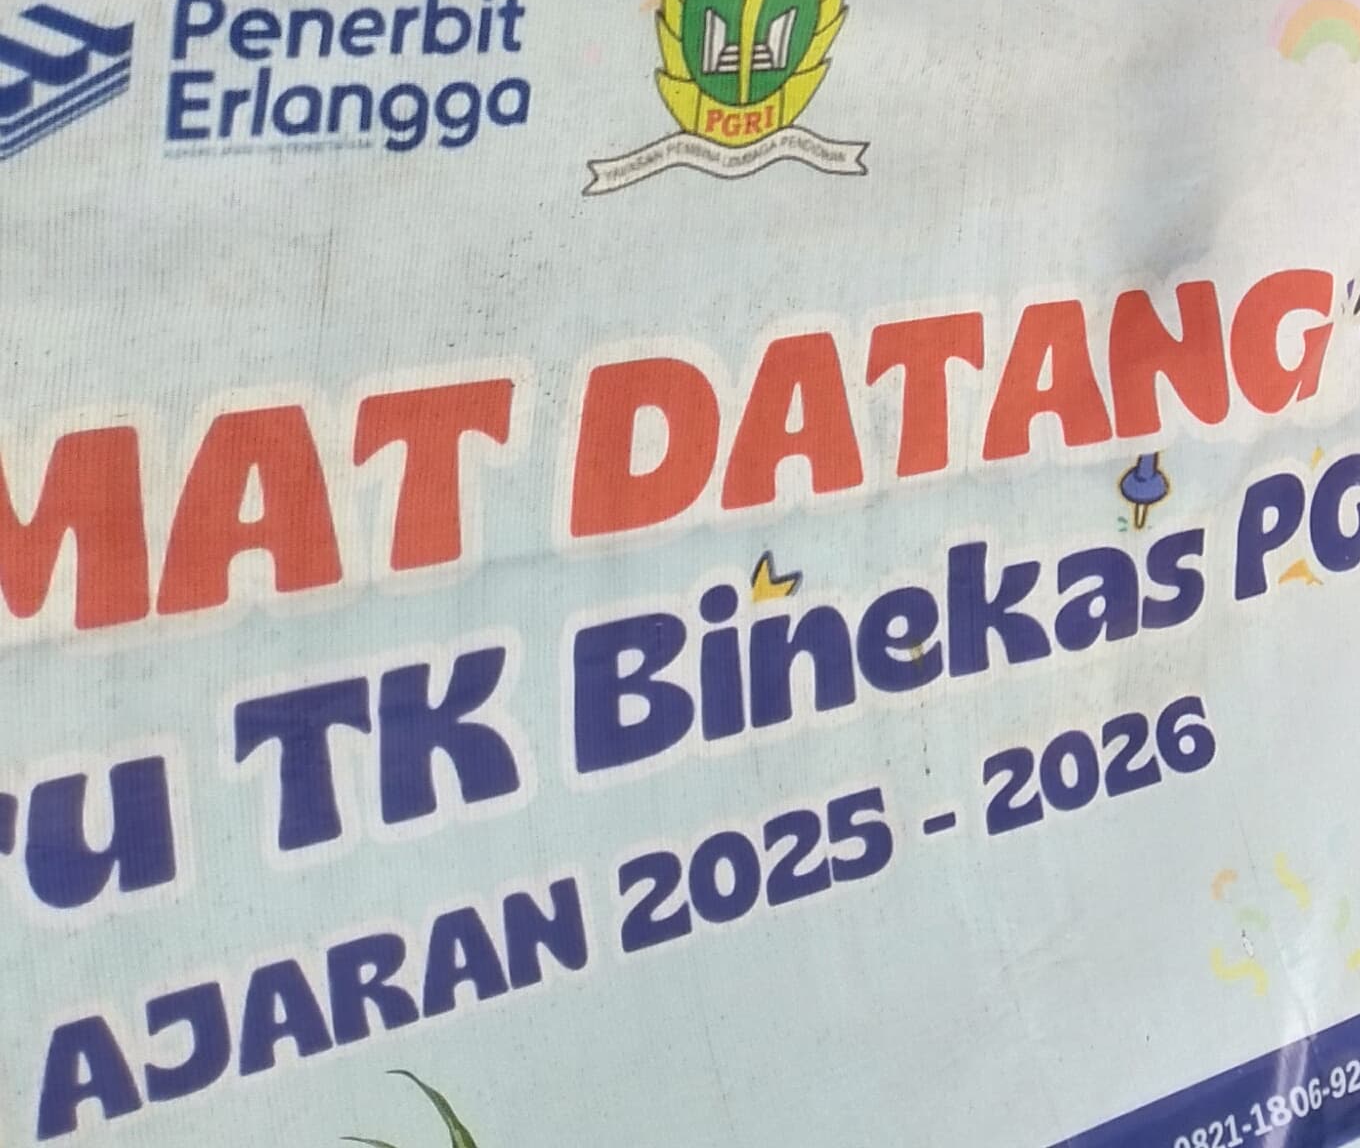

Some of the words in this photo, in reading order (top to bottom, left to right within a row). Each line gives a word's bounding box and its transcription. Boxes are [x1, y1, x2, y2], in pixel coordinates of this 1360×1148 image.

[165, 67, 531, 152] Erlangga
[704, 105, 776, 137] PGRI
[0, 378, 514, 630] MAT
[571, 268, 1334, 537] DATANG
[0, 756, 176, 909] u
[234, 647, 520, 851] TK
[574, 528, 1205, 774] Binekas
[36, 878, 588, 1142] AJARAN
[618, 787, 893, 953] 2025
[923, 812, 957, 835] -
[983, 695, 1216, 836] 2026
